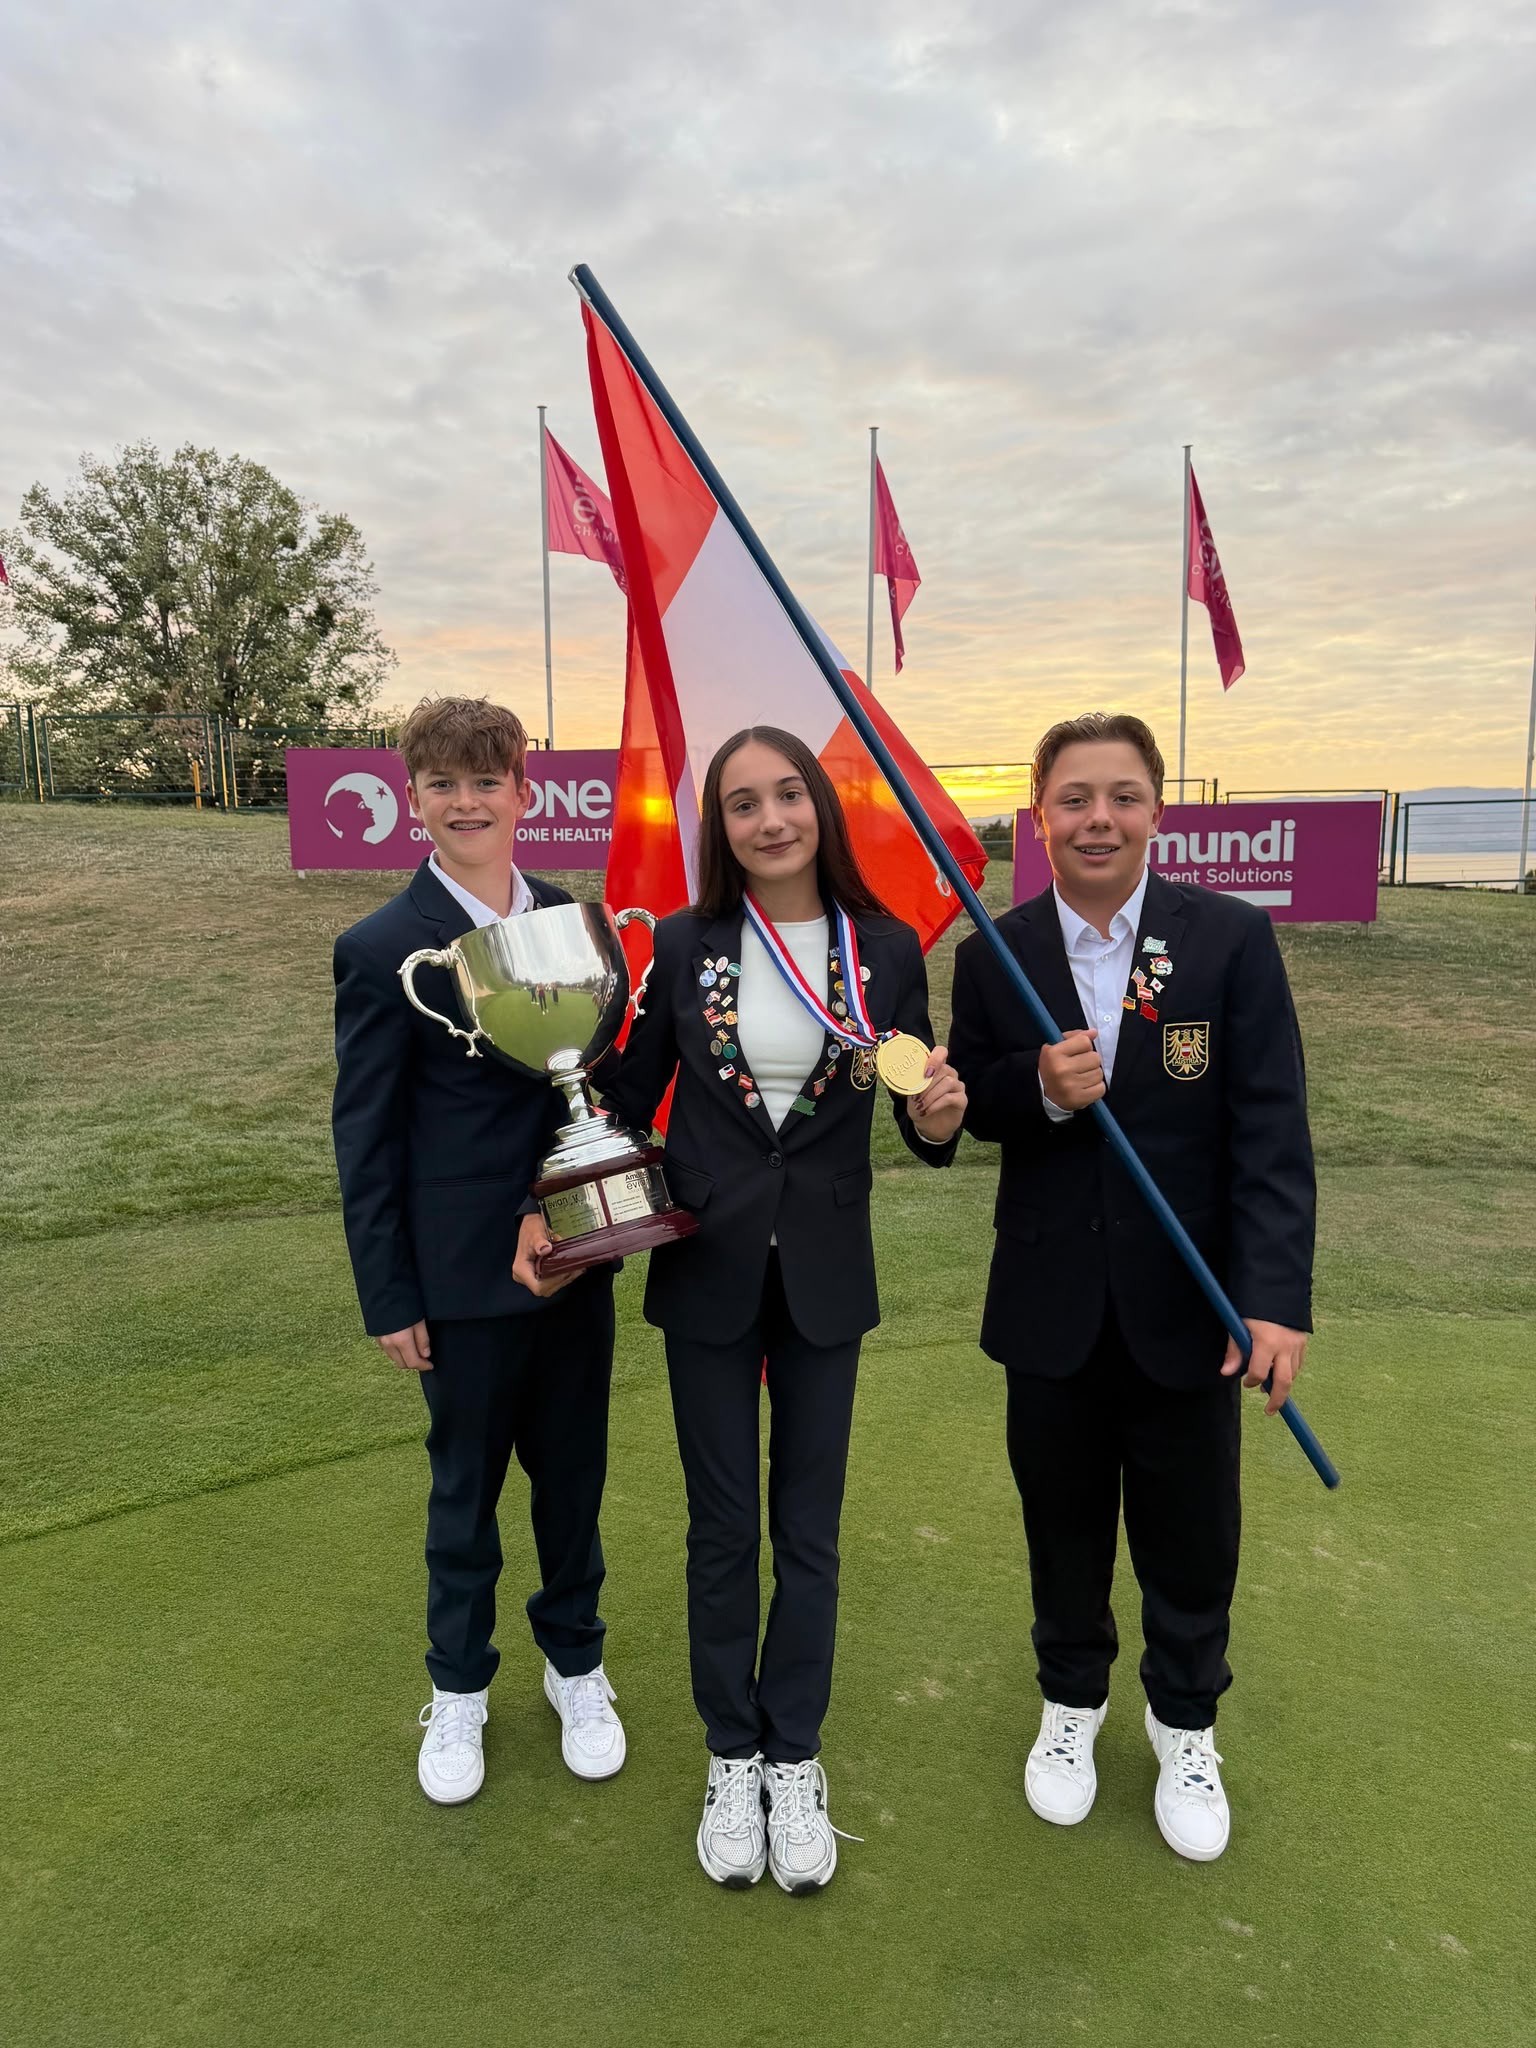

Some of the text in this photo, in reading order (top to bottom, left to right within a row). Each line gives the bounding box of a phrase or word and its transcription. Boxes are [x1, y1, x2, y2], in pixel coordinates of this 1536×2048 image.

[409, 827, 612, 842] ON ONE HEALTH
[1145, 819, 1296, 864] mundi
[1206, 867, 1293, 884] Solutions
